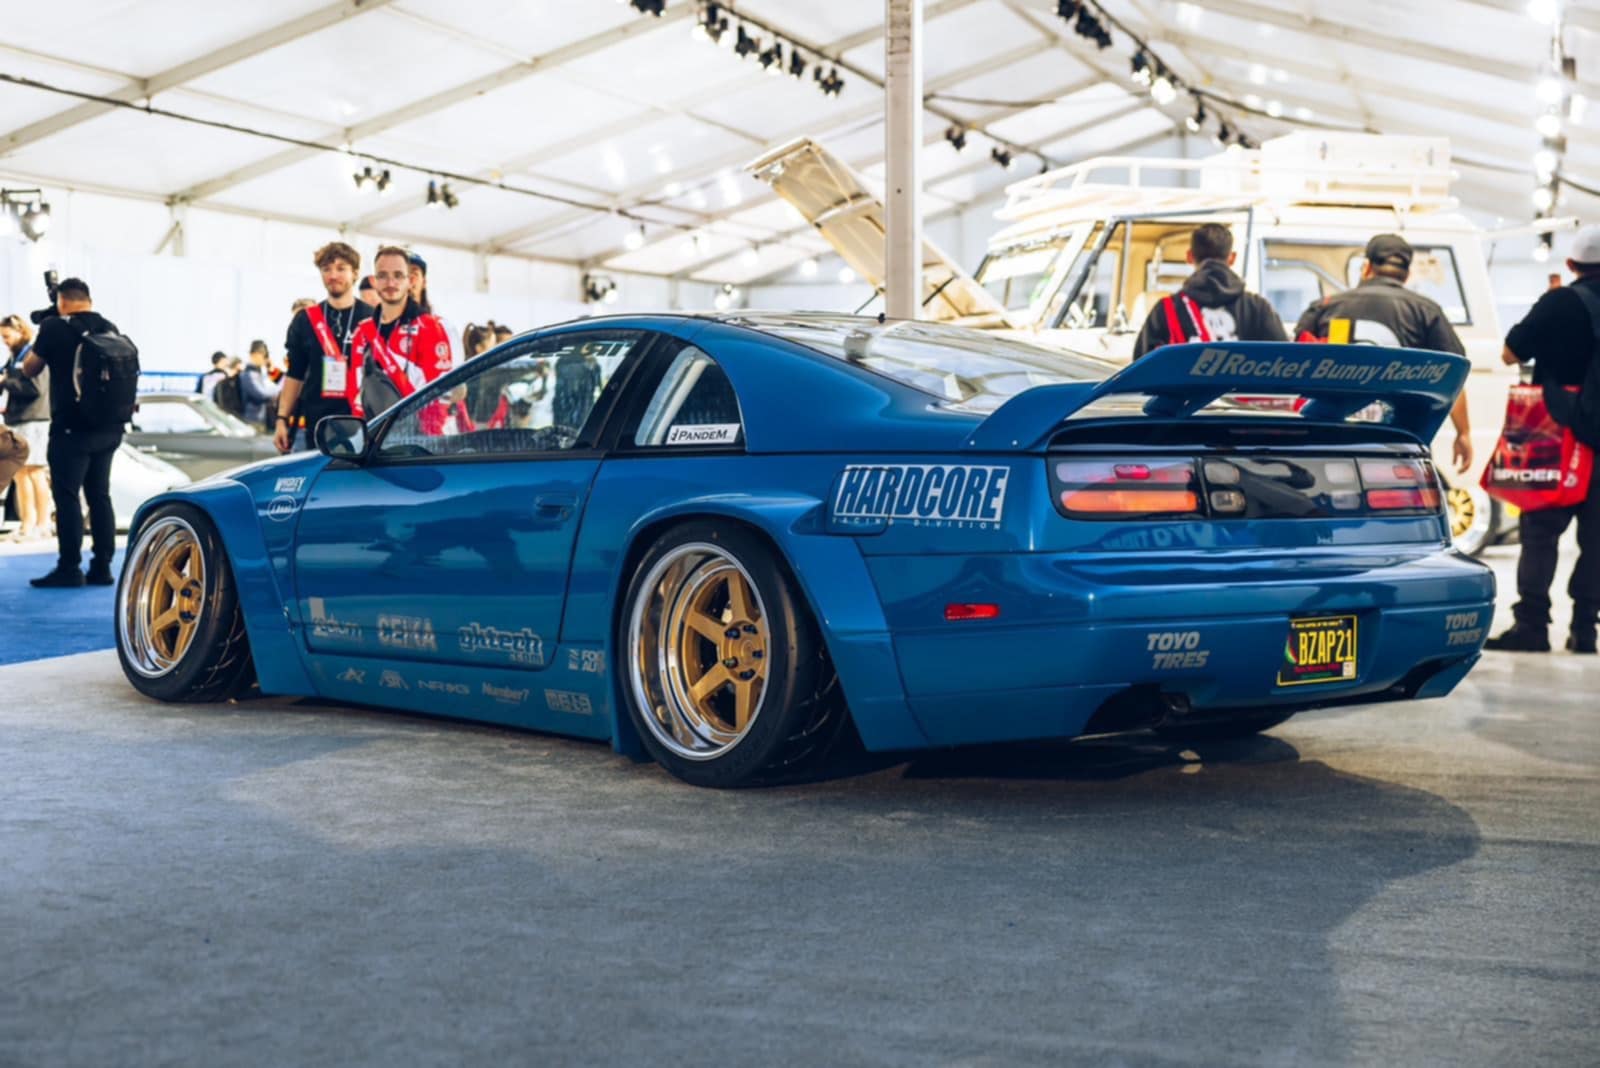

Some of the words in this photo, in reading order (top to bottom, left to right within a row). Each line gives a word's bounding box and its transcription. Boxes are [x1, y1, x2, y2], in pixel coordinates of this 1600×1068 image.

[1221, 356, 1312, 378] Rocket
[1312, 358, 1383, 384] Bunny
[1380, 360, 1451, 384] Racing
[836, 466, 1008, 520] HARDCORE
[1446, 612, 1479, 630] TOYO
[1147, 631, 1200, 651] TOYO
[1298, 629, 1354, 666] BZAP21
[1152, 650, 1210, 670] TIRES
